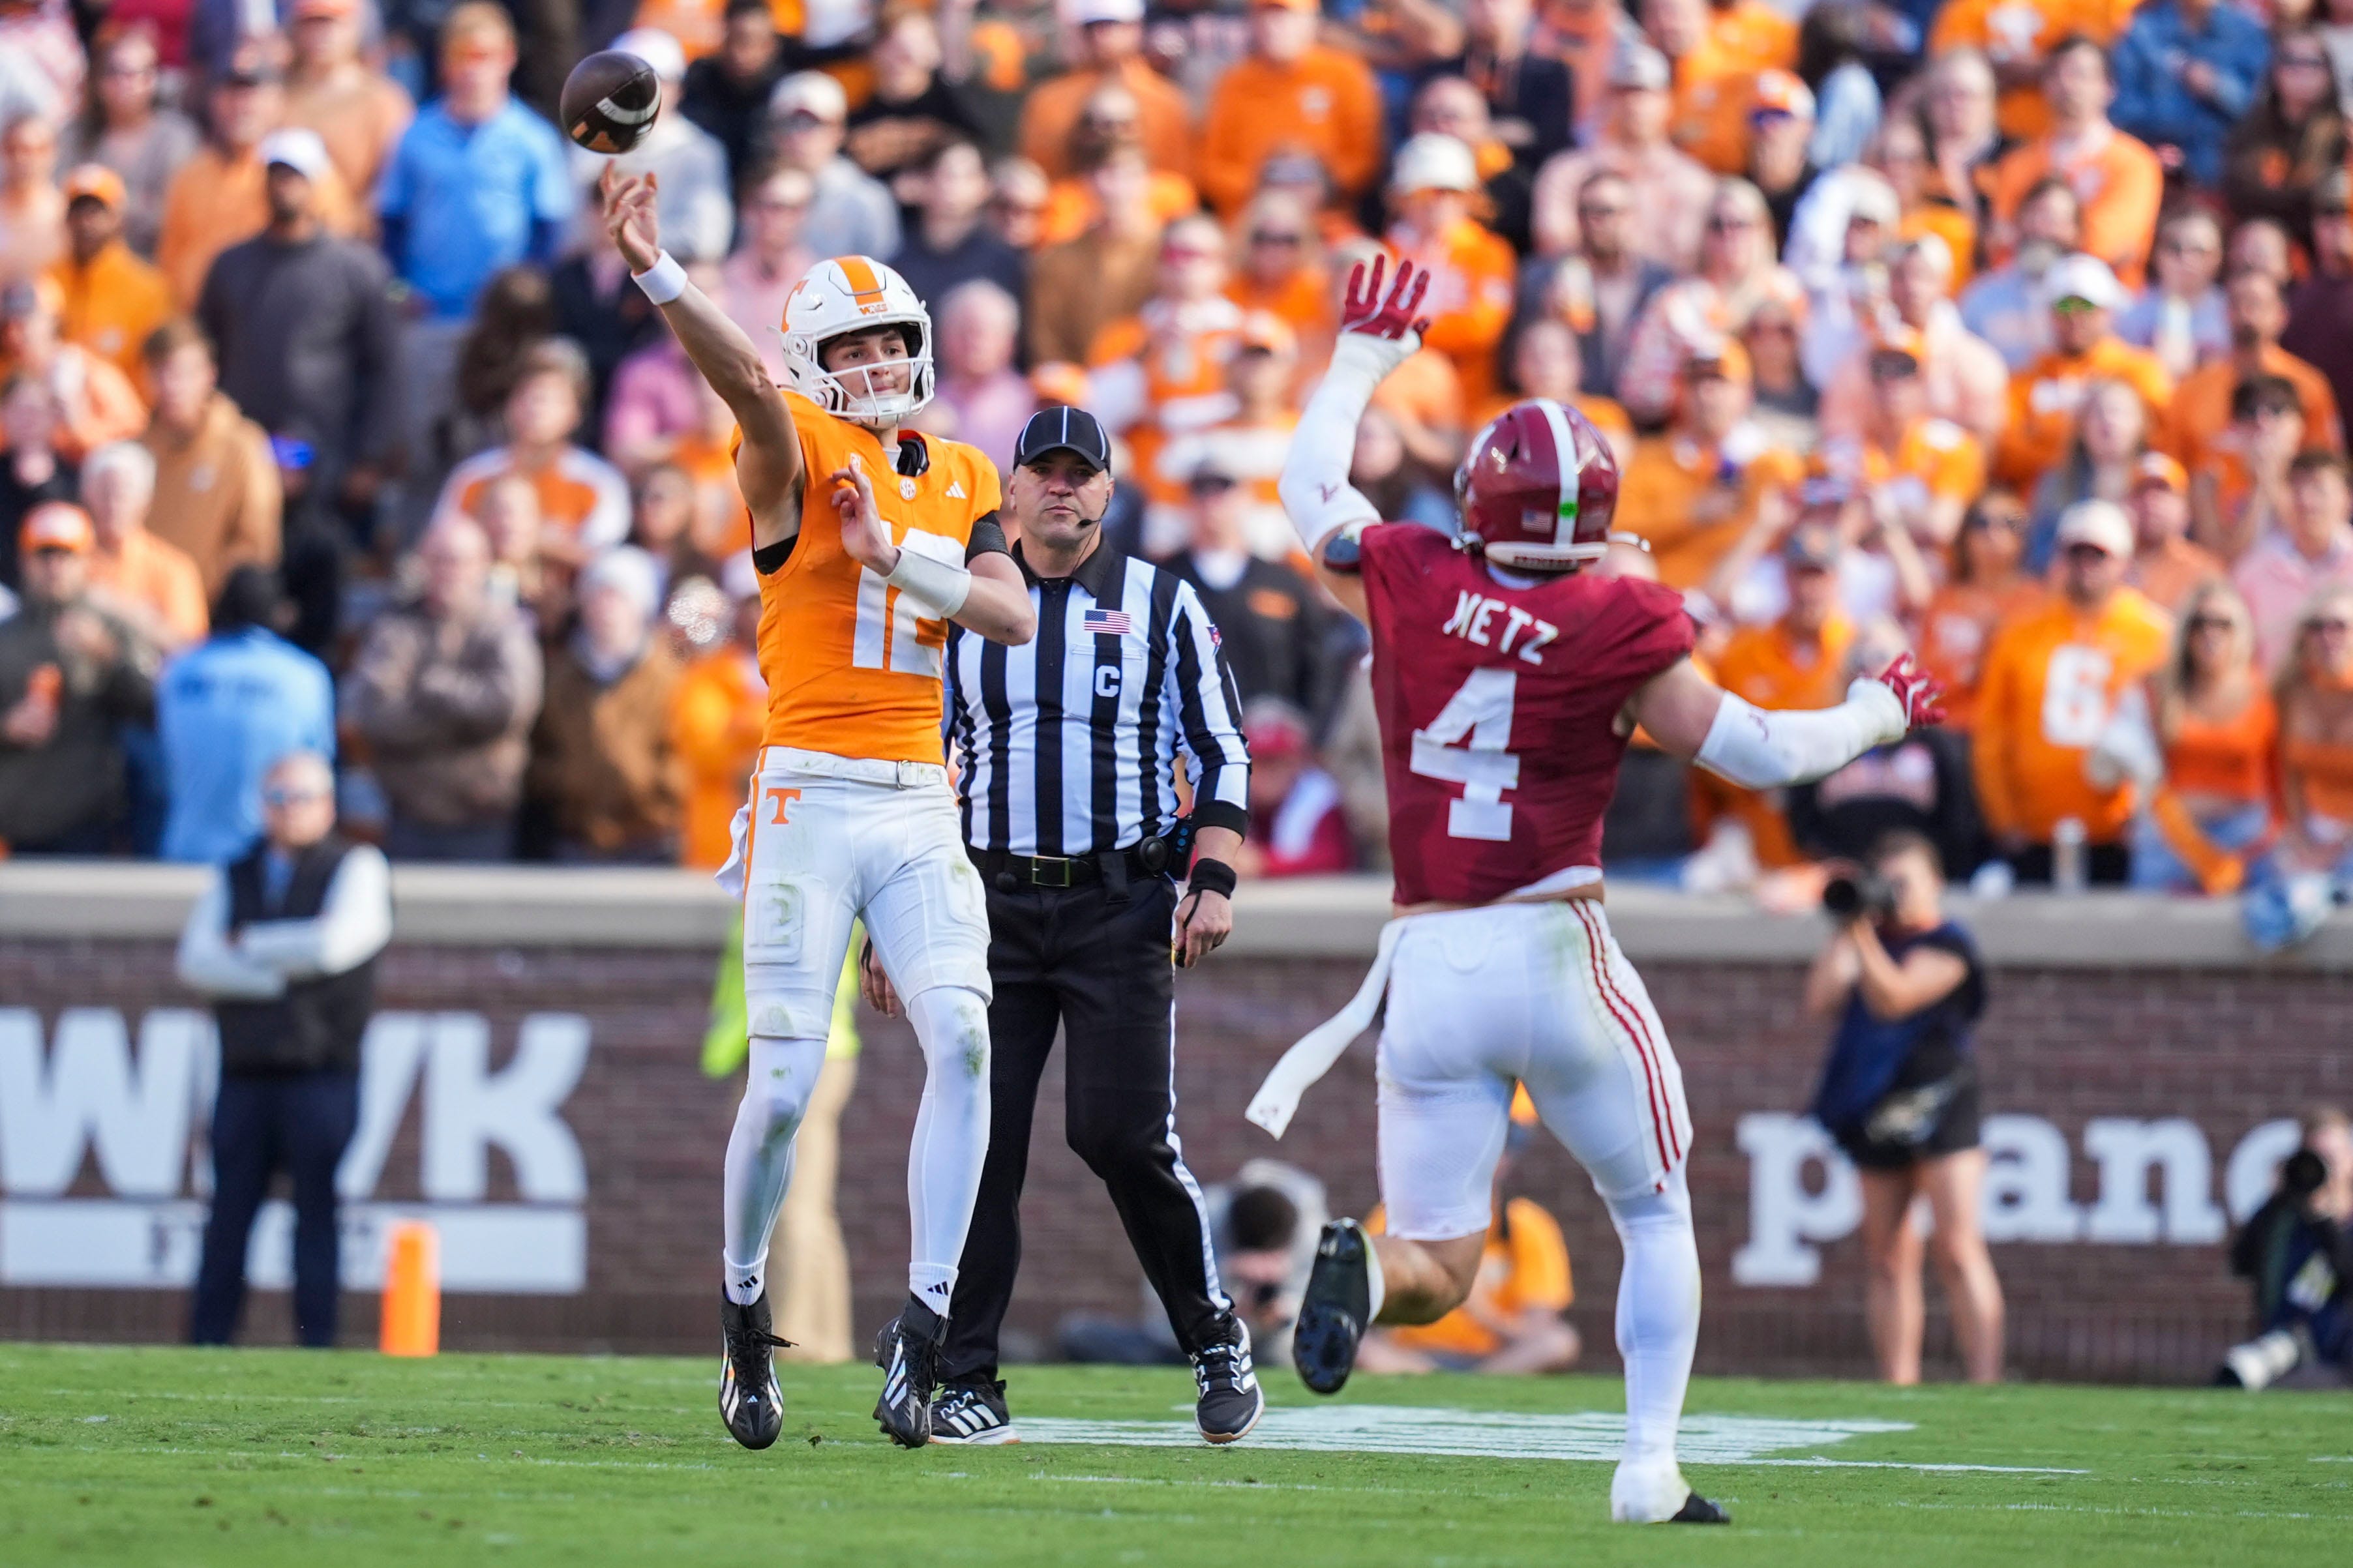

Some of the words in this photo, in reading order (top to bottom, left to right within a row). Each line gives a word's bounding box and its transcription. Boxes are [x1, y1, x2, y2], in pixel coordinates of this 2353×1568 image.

[901, 479, 915, 499] SEC
[1095, 665, 1120, 698] C
[2041, 642, 2113, 747] 6
[1410, 666, 1520, 841] 4
[766, 788, 802, 825] T
